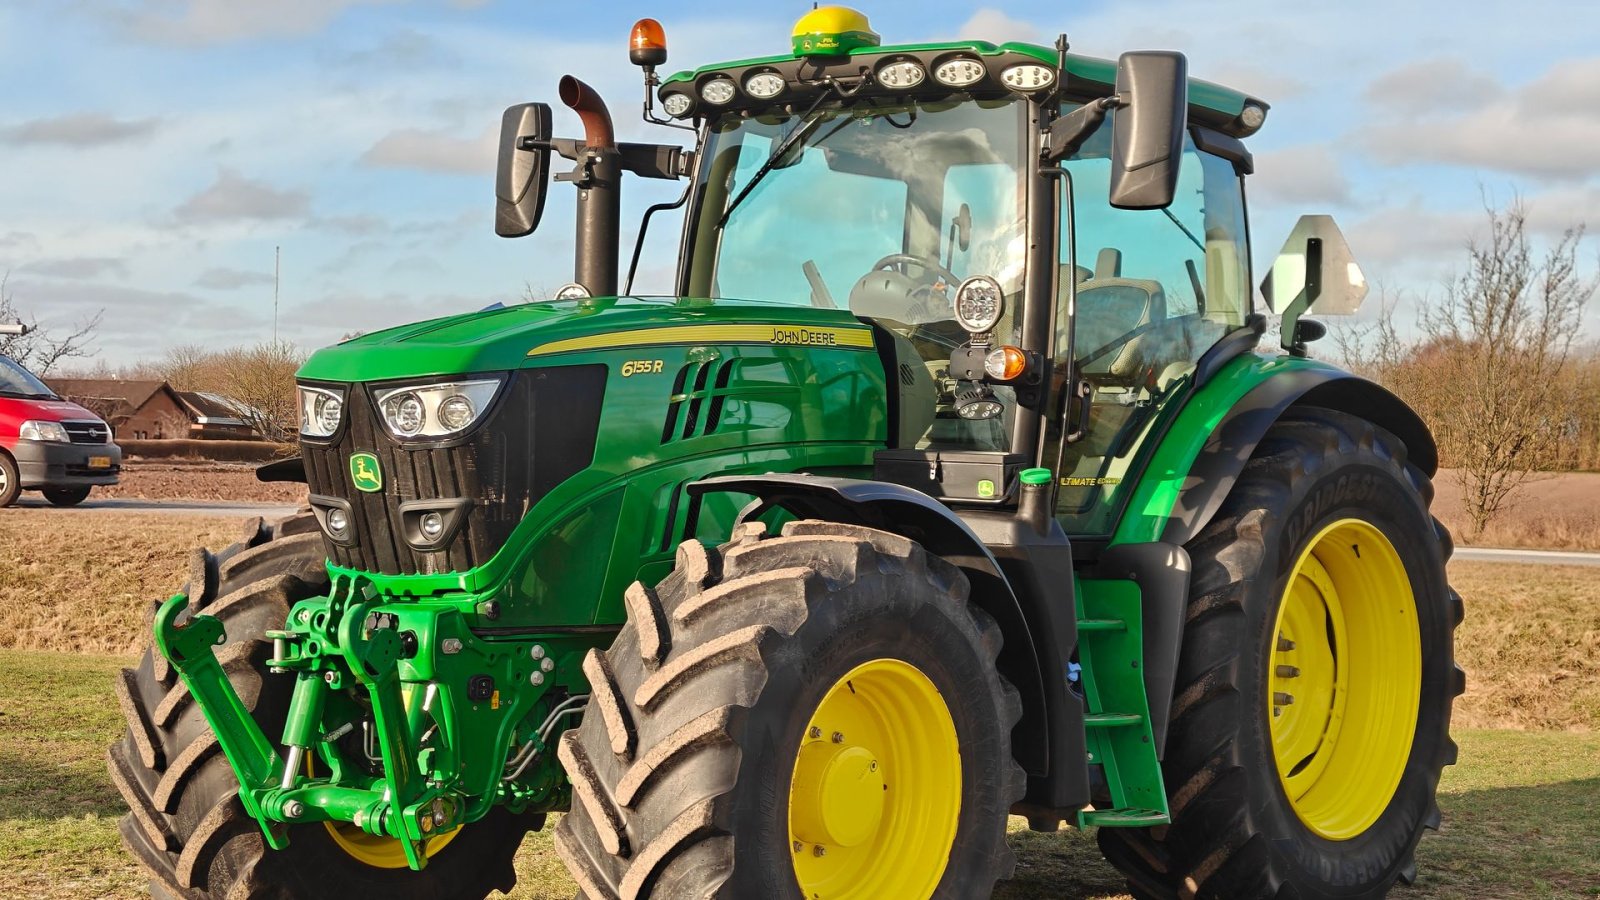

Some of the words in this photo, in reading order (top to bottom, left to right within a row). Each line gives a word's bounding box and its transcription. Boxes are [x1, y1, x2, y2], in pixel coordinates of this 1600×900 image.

[770, 327, 800, 343] JOHN
[800, 329, 836, 345] DEERE
[1060, 477, 1097, 486] LTIMATE
